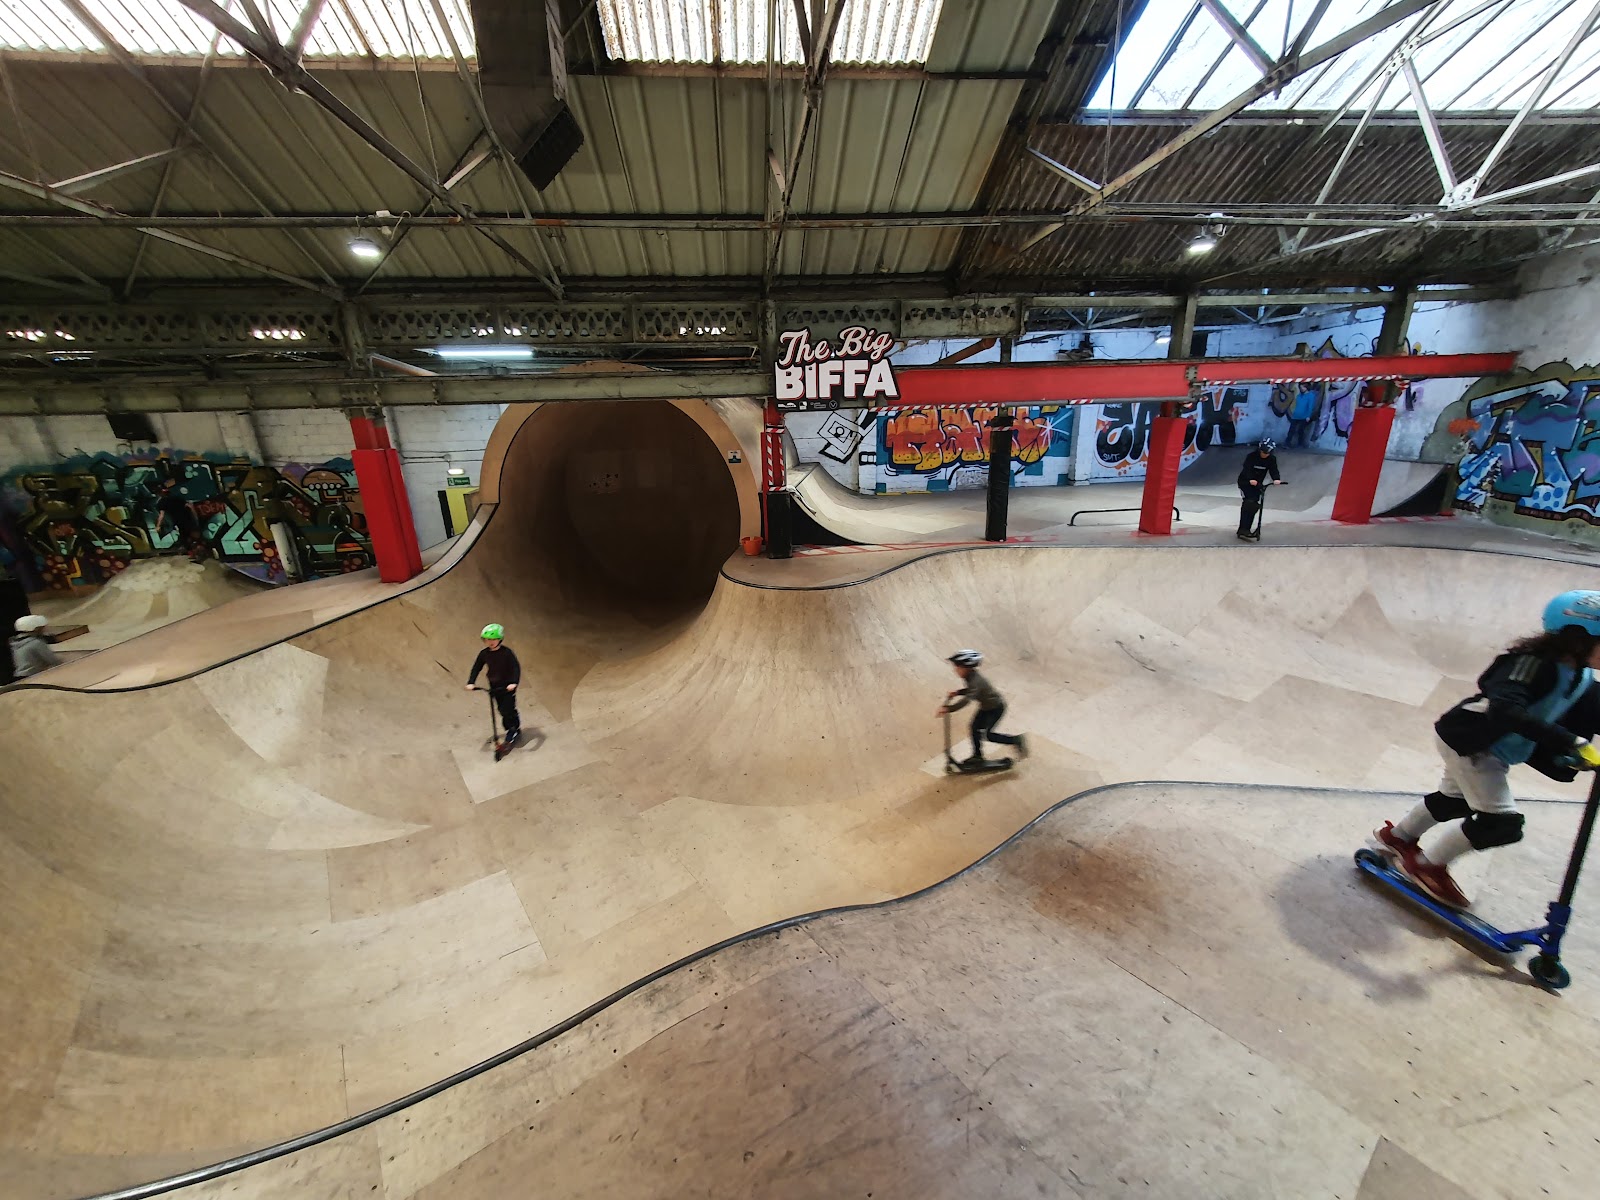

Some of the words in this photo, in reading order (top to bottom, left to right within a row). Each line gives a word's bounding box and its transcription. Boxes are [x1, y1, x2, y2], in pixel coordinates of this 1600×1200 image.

[778, 328, 832, 367] The
[835, 326, 893, 360] Big
[775, 358, 899, 400] BIFFA
